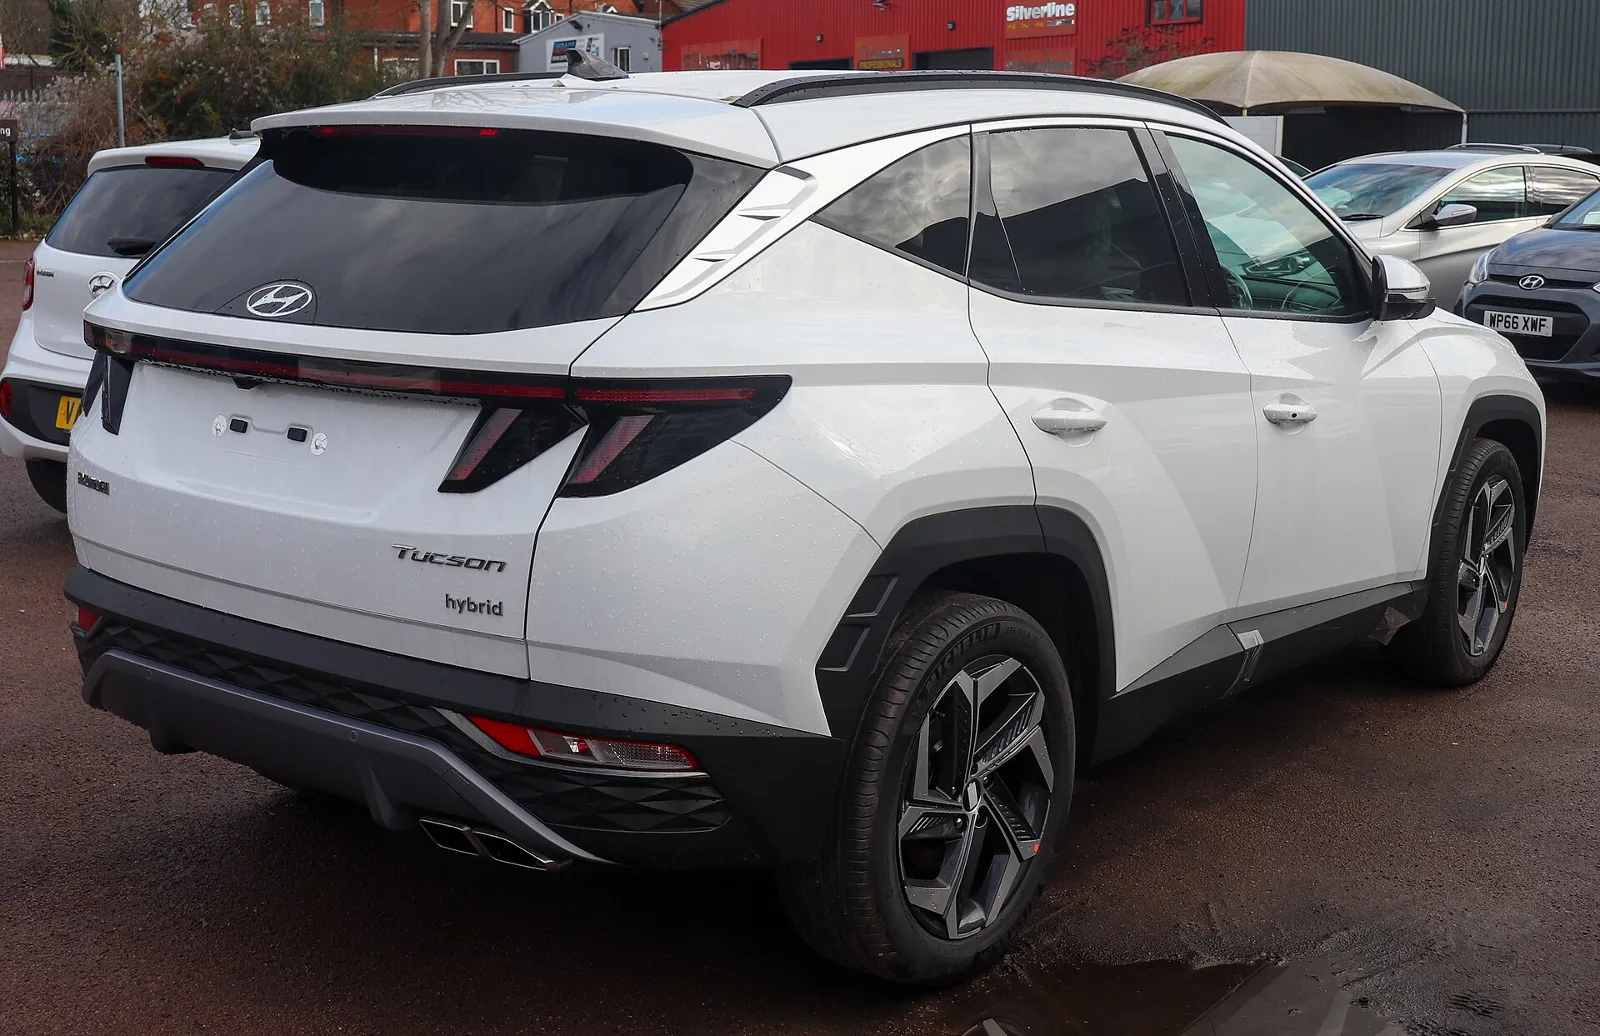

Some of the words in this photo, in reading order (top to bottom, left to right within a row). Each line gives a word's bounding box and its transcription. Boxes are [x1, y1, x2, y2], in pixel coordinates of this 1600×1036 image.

[1006, 2, 1075, 21] Silverline
[1489, 313, 1519, 330] WP66
[1522, 316, 1547, 333] XWF
[446, 593, 504, 616] hybrid
